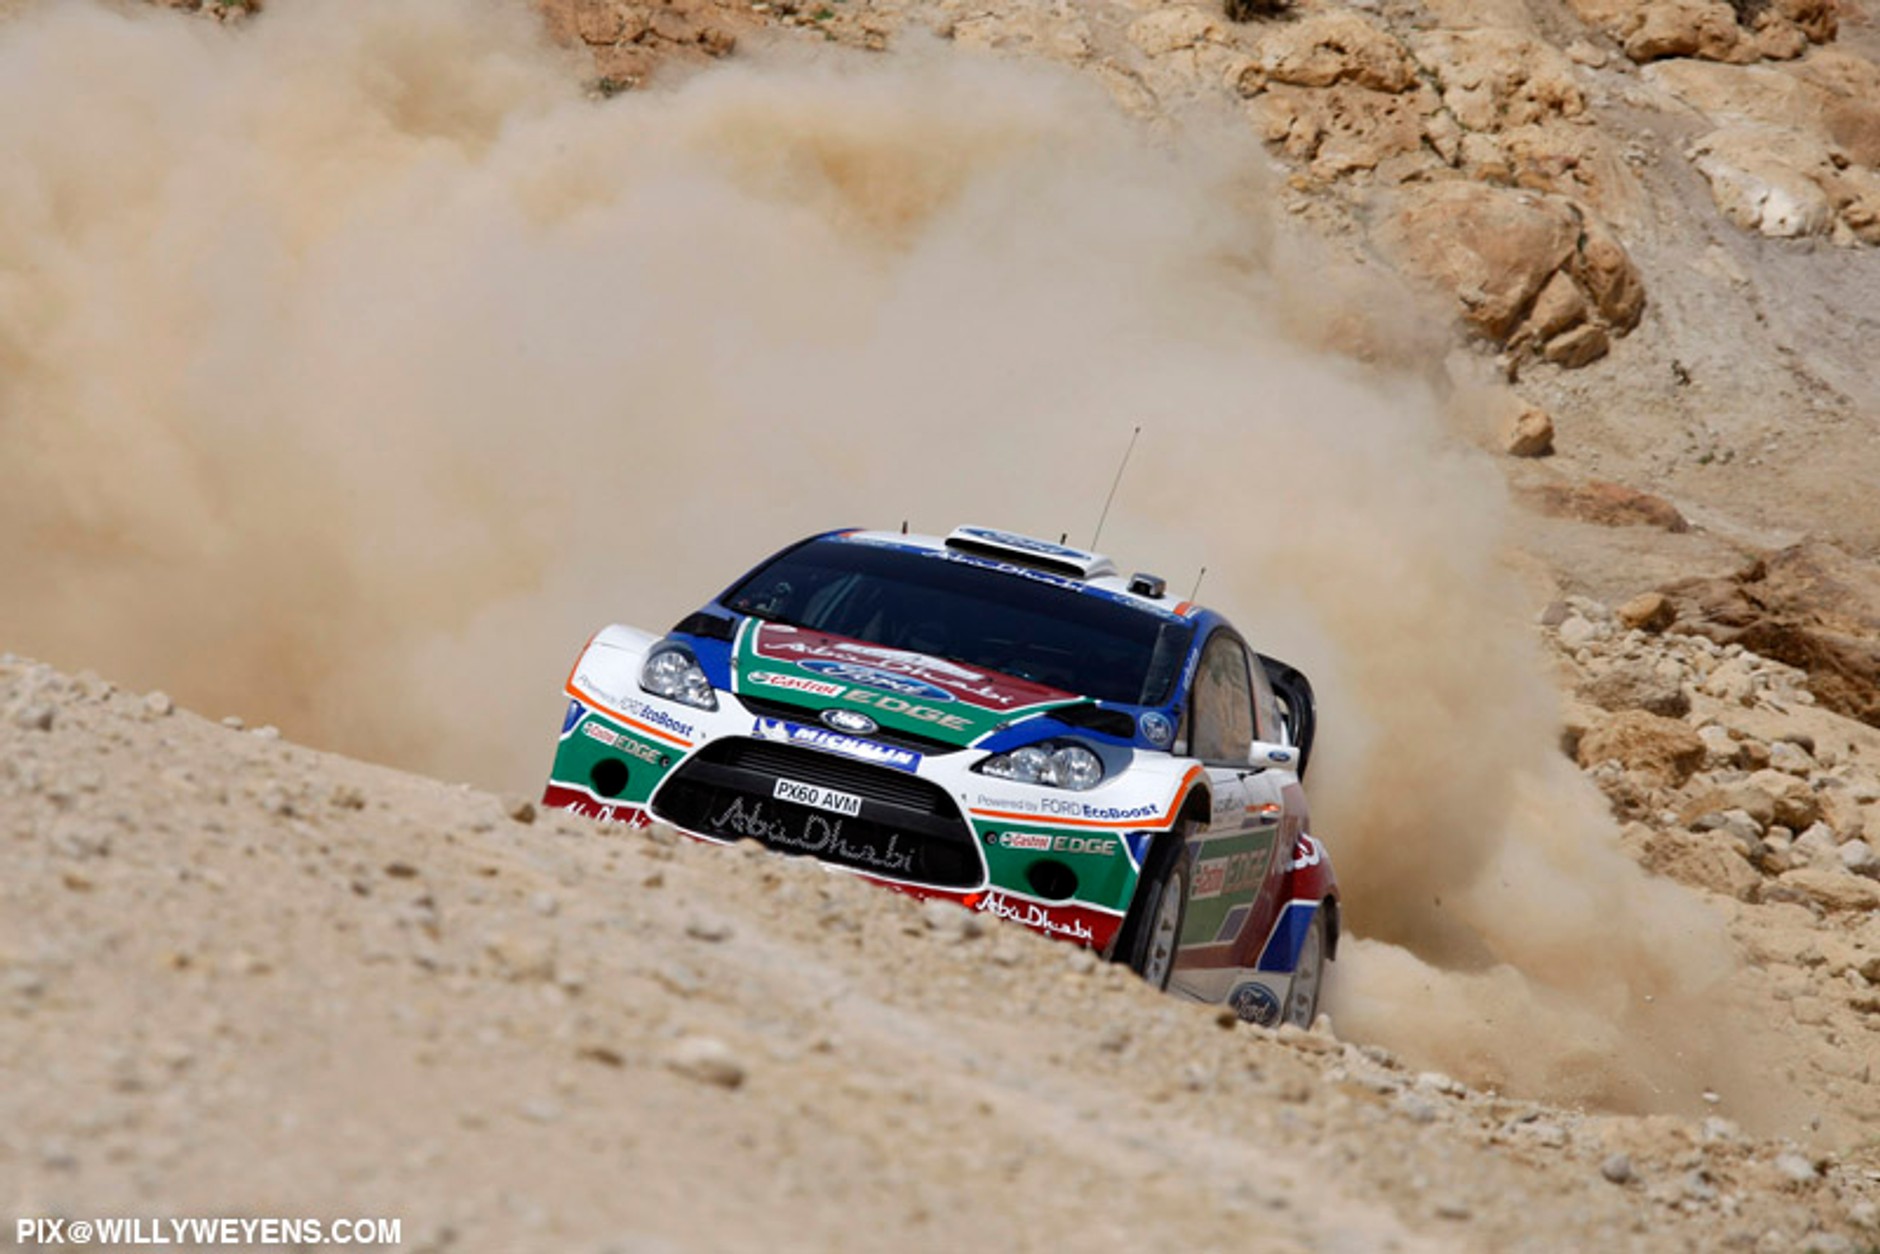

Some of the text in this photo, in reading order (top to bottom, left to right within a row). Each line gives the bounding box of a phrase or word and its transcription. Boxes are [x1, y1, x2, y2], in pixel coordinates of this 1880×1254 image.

[768, 674, 976, 732] Castrol EDGE
[640, 704, 695, 738] EcoBoost
[615, 734, 662, 765] EDGE
[791, 725, 915, 766] MICHELIN
[777, 780, 859, 814] PX60 AVM
[977, 793, 1024, 810] Powered
[1041, 798, 1082, 816] FORD
[1082, 803, 1160, 819] EcoBoost
[711, 796, 916, 873] Abu Dhabi
[1053, 835, 1118, 856] EDGE
[976, 891, 1094, 940] Abu Dhabi
